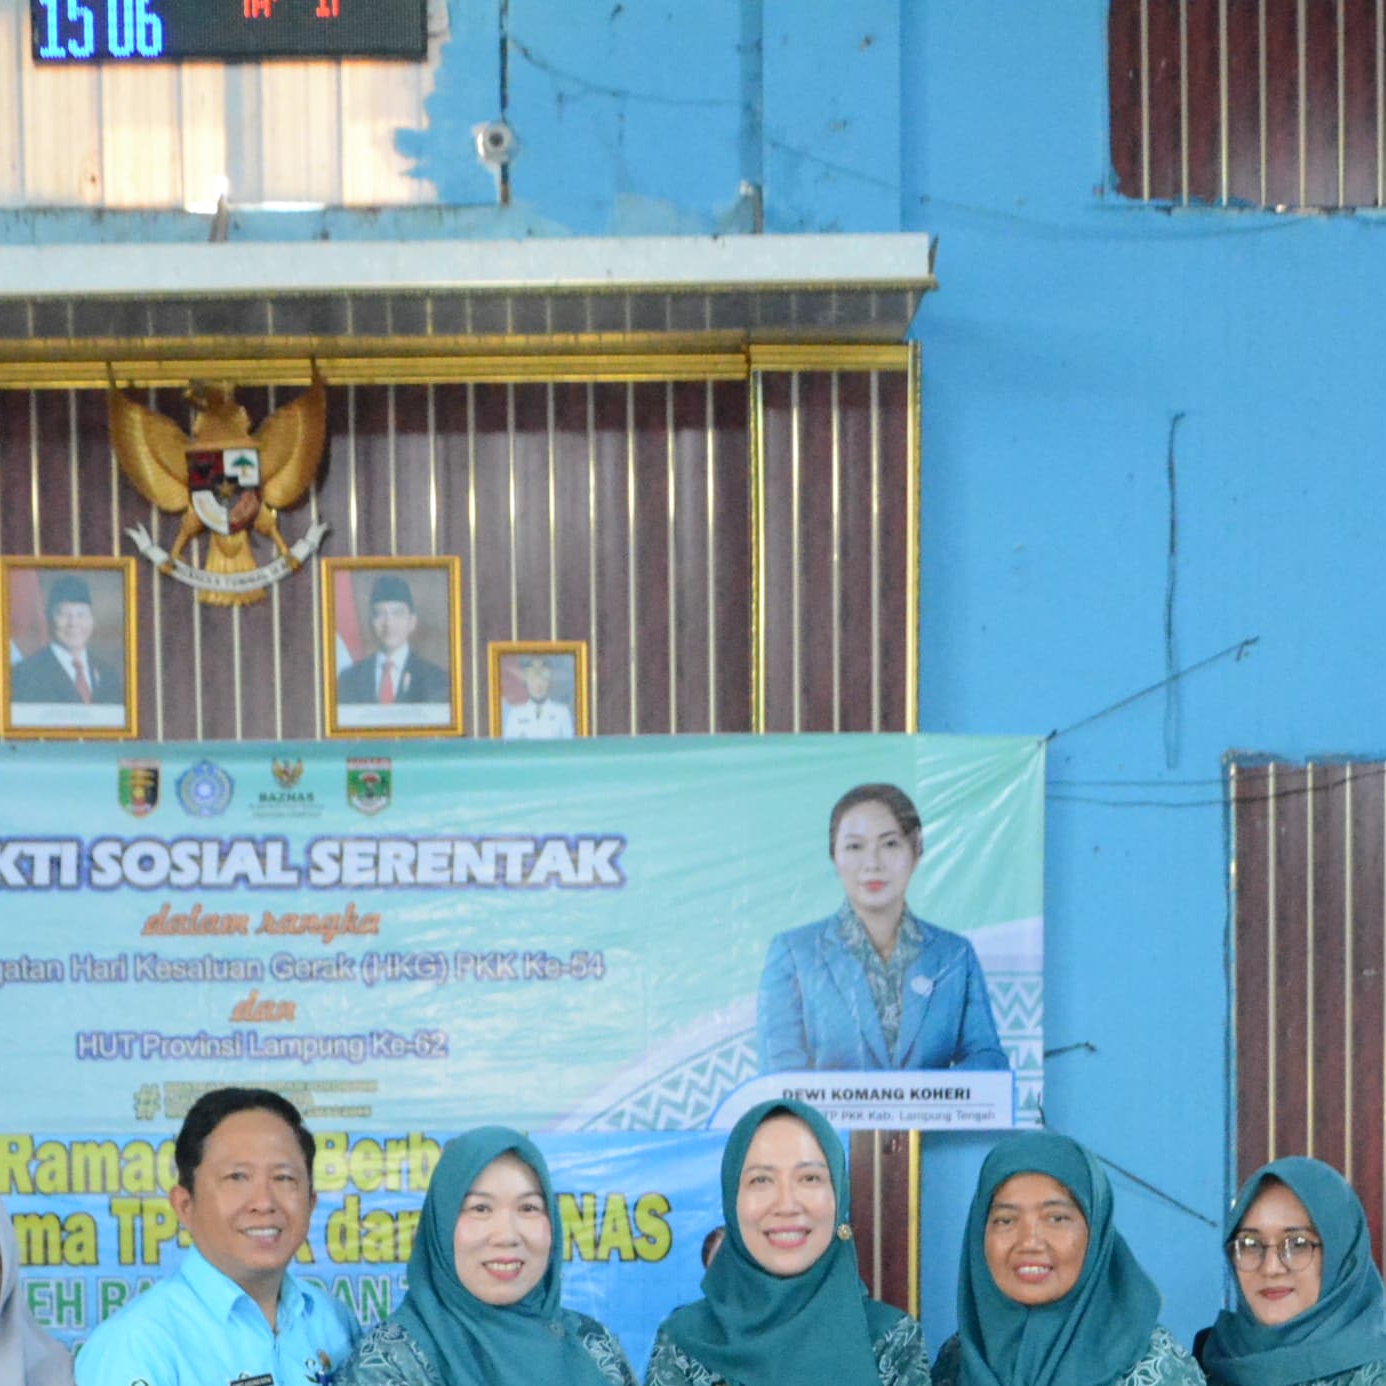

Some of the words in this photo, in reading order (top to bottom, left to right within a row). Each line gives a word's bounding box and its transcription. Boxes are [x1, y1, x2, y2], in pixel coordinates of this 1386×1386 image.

[88, 837, 302, 889] SOSIAL
[308, 837, 624, 888] SERENTAK
[141, 902, 249, 936] dalam
[255, 902, 381, 944] rangka
[70, 955, 127, 981] Hari
[134, 953, 264, 981] Kesatuan
[270, 953, 355, 980] Gerak
[363, 952, 448, 985] (HKG)
[454, 953, 517, 980] PKK
[523, 952, 606, 979] Ke-54
[228, 989, 297, 1022] dan
[78, 1032, 136, 1057] HUT
[142, 1030, 244, 1058] Provinsi
[248, 1032, 365, 1063] Lampung
[371, 1031, 448, 1057] Ke-62
[782, 1088, 826, 1100] DEWI
[831, 1088, 905, 1100] KOMANG
[910, 1087, 971, 1100] KOHERI
[841, 1111, 864, 1121] PKK
[899, 1110, 953, 1123] Lampung
[957, 1109, 996, 1123] Tengah
